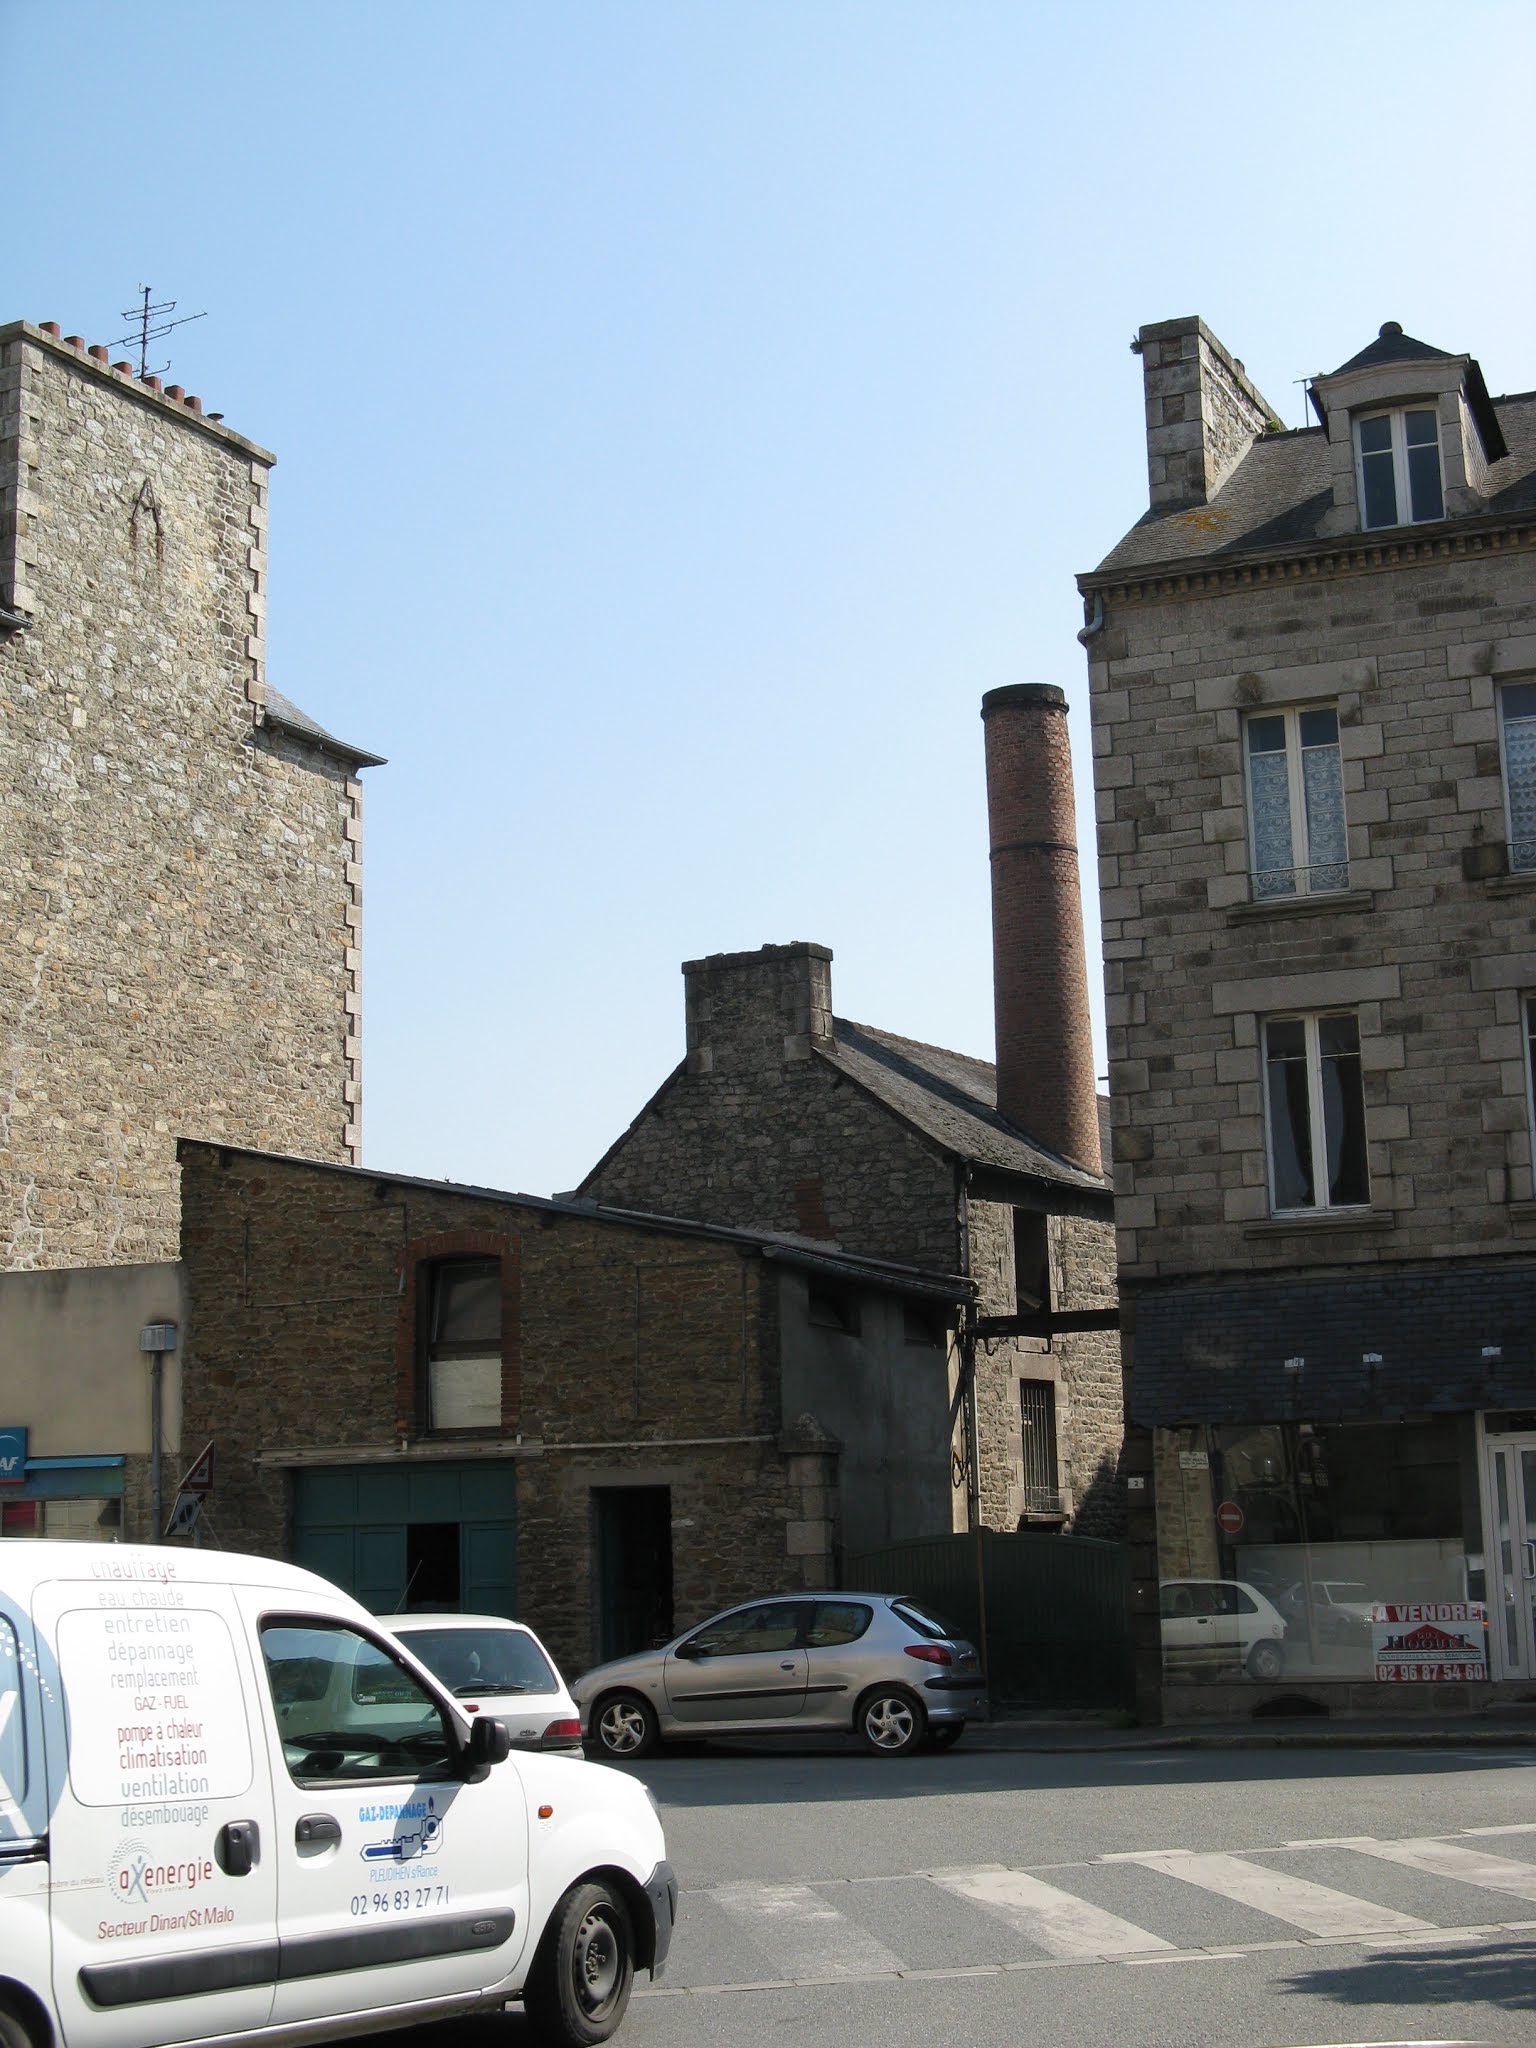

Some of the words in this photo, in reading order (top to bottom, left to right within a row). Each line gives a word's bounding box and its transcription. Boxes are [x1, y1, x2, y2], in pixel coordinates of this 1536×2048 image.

[98, 1592, 126, 1606] eau
[132, 1585, 185, 1606] chaude
[104, 1611, 191, 1633] entretien
[1375, 1606, 1389, 1621] A
[1395, 1604, 1482, 1622] VENDRE
[108, 1640, 194, 1666] dépannage
[111, 1664, 200, 1694] remplacement
[1379, 1665, 1396, 1681] 02
[1400, 1665, 1417, 1681] 96
[1422, 1665, 1438, 1681] 87
[1443, 1665, 1460, 1681] 54
[1465, 1664, 1482, 1680] 60
[134, 1696, 157, 1711] GAZ
[164, 1695, 190, 1710] FUEL
[117, 1725, 153, 1749] pompe
[156, 1721, 163, 1740] à
[167, 1717, 203, 1740] chaleur
[120, 1744, 208, 1769] climatisation
[121, 1772, 209, 1798] ventilation
[121, 1804, 209, 1828] désembouage
[359, 1803, 427, 1823] GAZ-DEPANNAGE
[351, 1895, 368, 1916] 02
[373, 1893, 389, 1912] 96
[394, 1890, 410, 1910] 83
[415, 1888, 431, 1908] 27
[436, 1886, 449, 1905] 71
[98, 1921, 149, 1939] Secteur
[204, 1905, 235, 1925] Malo
